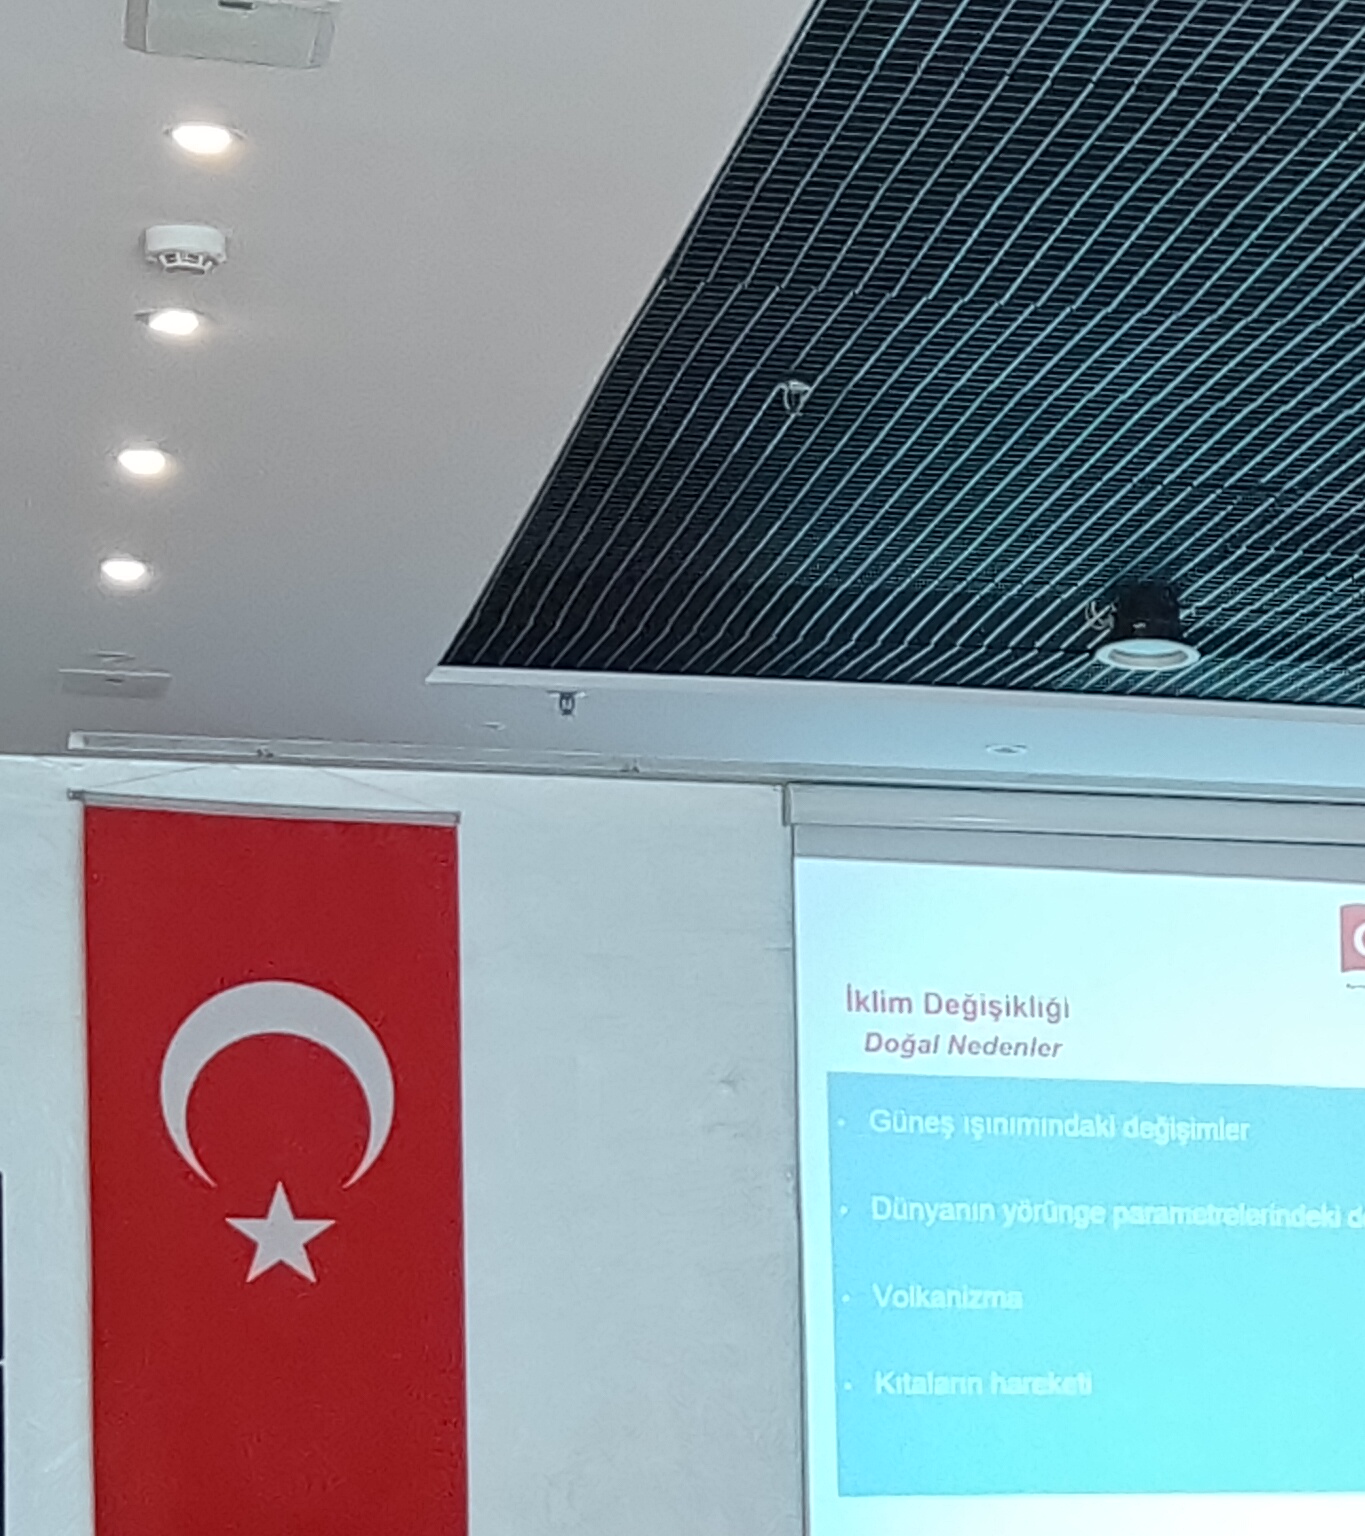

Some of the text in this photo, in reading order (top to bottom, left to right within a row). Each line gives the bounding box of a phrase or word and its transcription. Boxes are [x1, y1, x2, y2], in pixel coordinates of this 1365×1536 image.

[847, 983, 1070, 1023] İklim Değişikliği
[864, 1032, 1063, 1059] Doğal Nedenler
[869, 1108, 1250, 1146] Güneş ışınımındaki değişimler
[871, 1195, 995, 1227] Dünyanın
[1001, 1199, 1106, 1230] yörünge
[1112, 1203, 1342, 1231] parametrelerindeki
[871, 1283, 1024, 1310] Volkanizma
[875, 1370, 1093, 1397] Kıtaların hareketi
